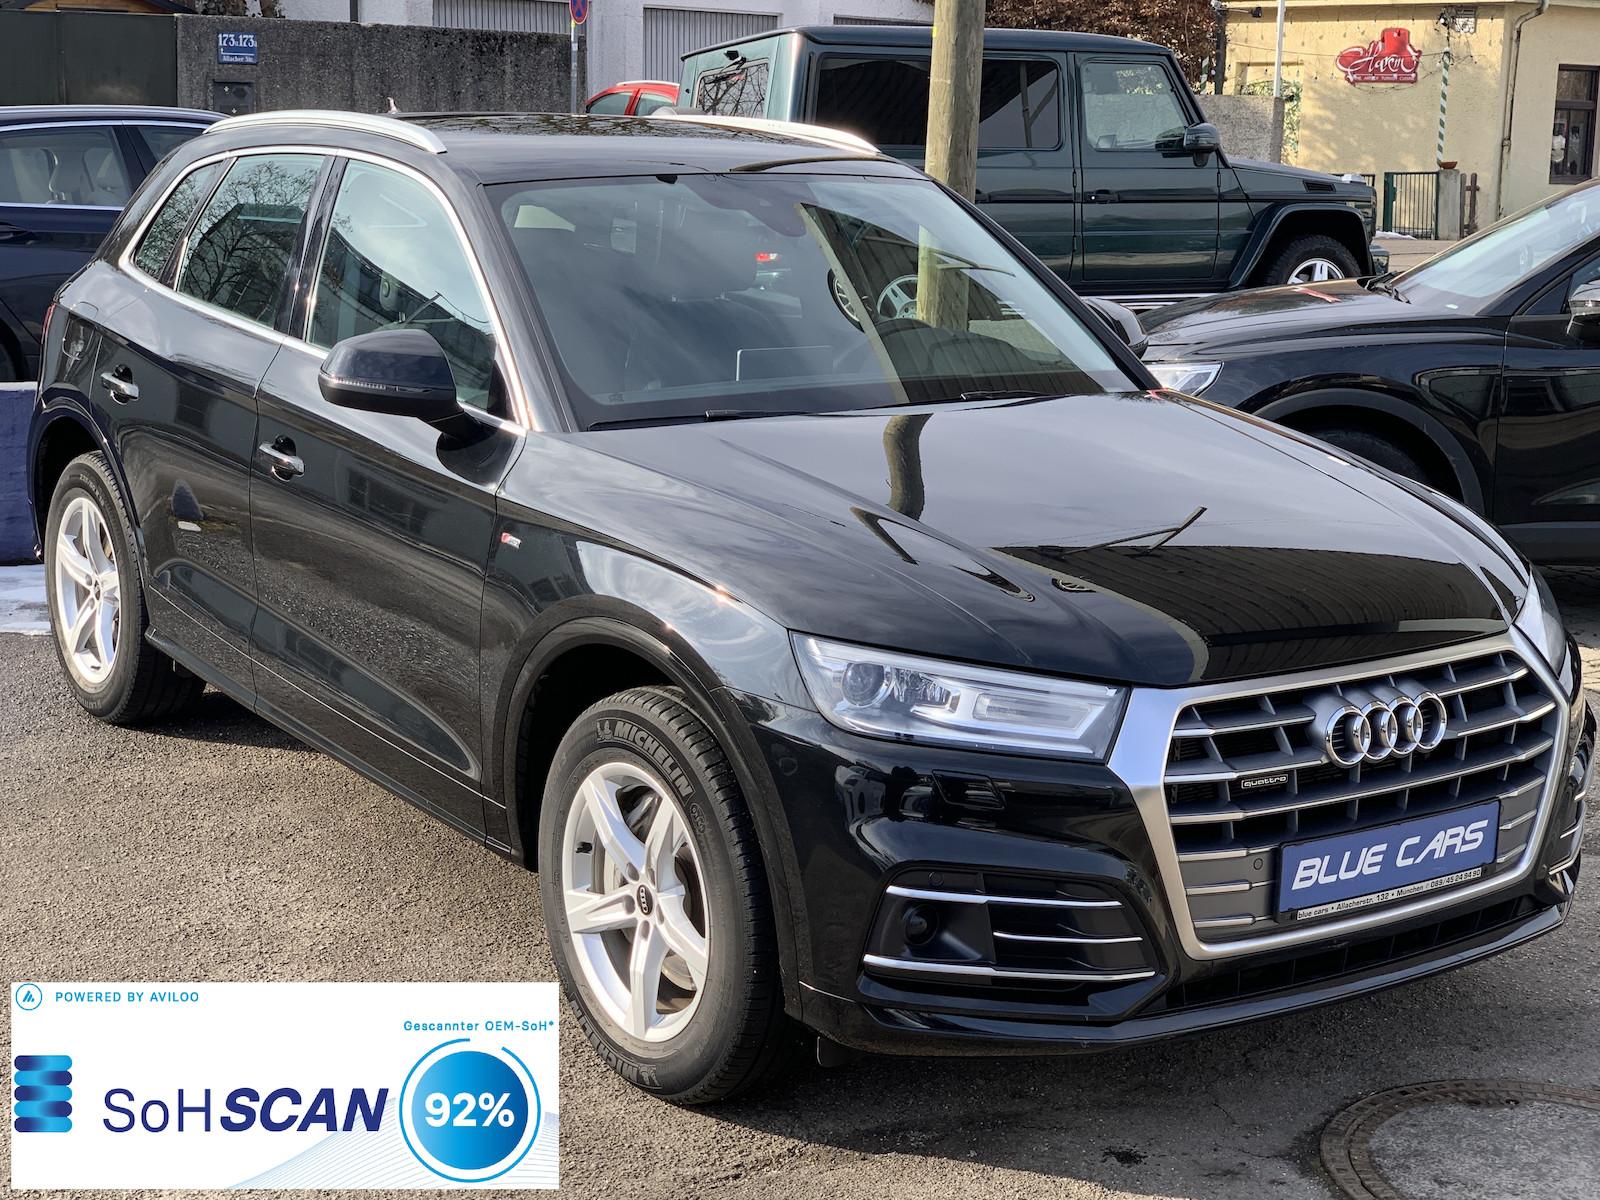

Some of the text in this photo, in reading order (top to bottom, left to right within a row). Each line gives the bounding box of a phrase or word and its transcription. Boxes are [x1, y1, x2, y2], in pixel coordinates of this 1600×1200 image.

[613, 719, 693, 799] MICHELIN
[1243, 776, 1287, 788] quattro
[1291, 819, 1489, 891] BLUE CARS
[1298, 911, 1312, 919] blue
[1313, 907, 1329, 916] cars
[1376, 892, 1390, 902] 132
